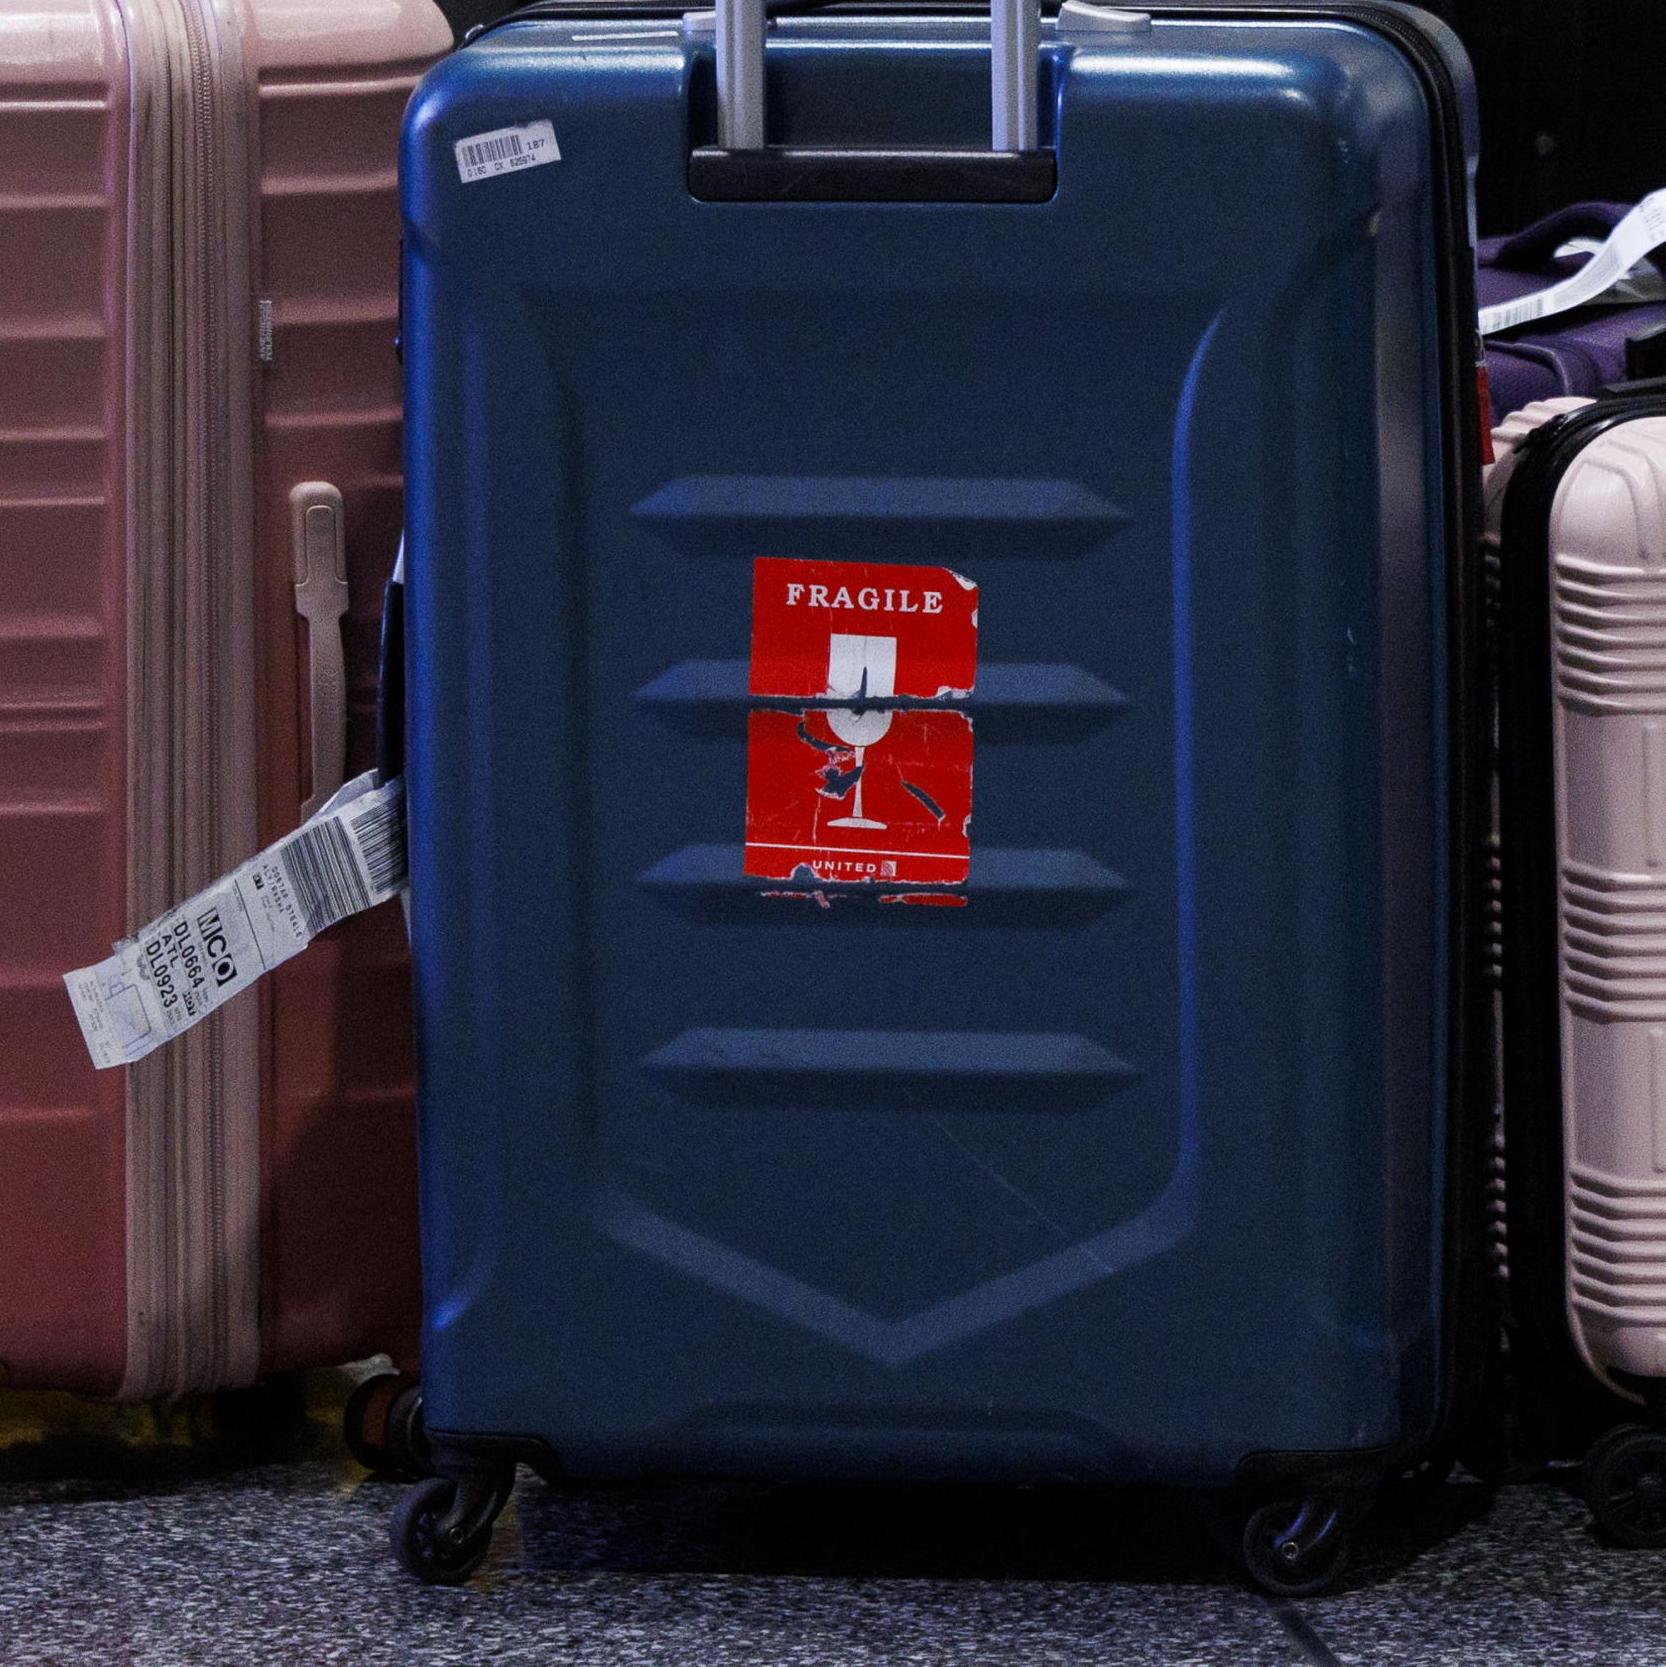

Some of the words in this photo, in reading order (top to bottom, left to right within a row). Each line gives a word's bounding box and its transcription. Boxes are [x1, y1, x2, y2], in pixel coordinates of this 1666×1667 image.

[786, 583, 944, 614] FRAGILE
[812, 859, 877, 874] UNITED
[161, 933, 179, 968] ATL
[173, 921, 205, 989] DL0664
[196, 906, 238, 987] MCO
[145, 940, 178, 1008] DL0923
